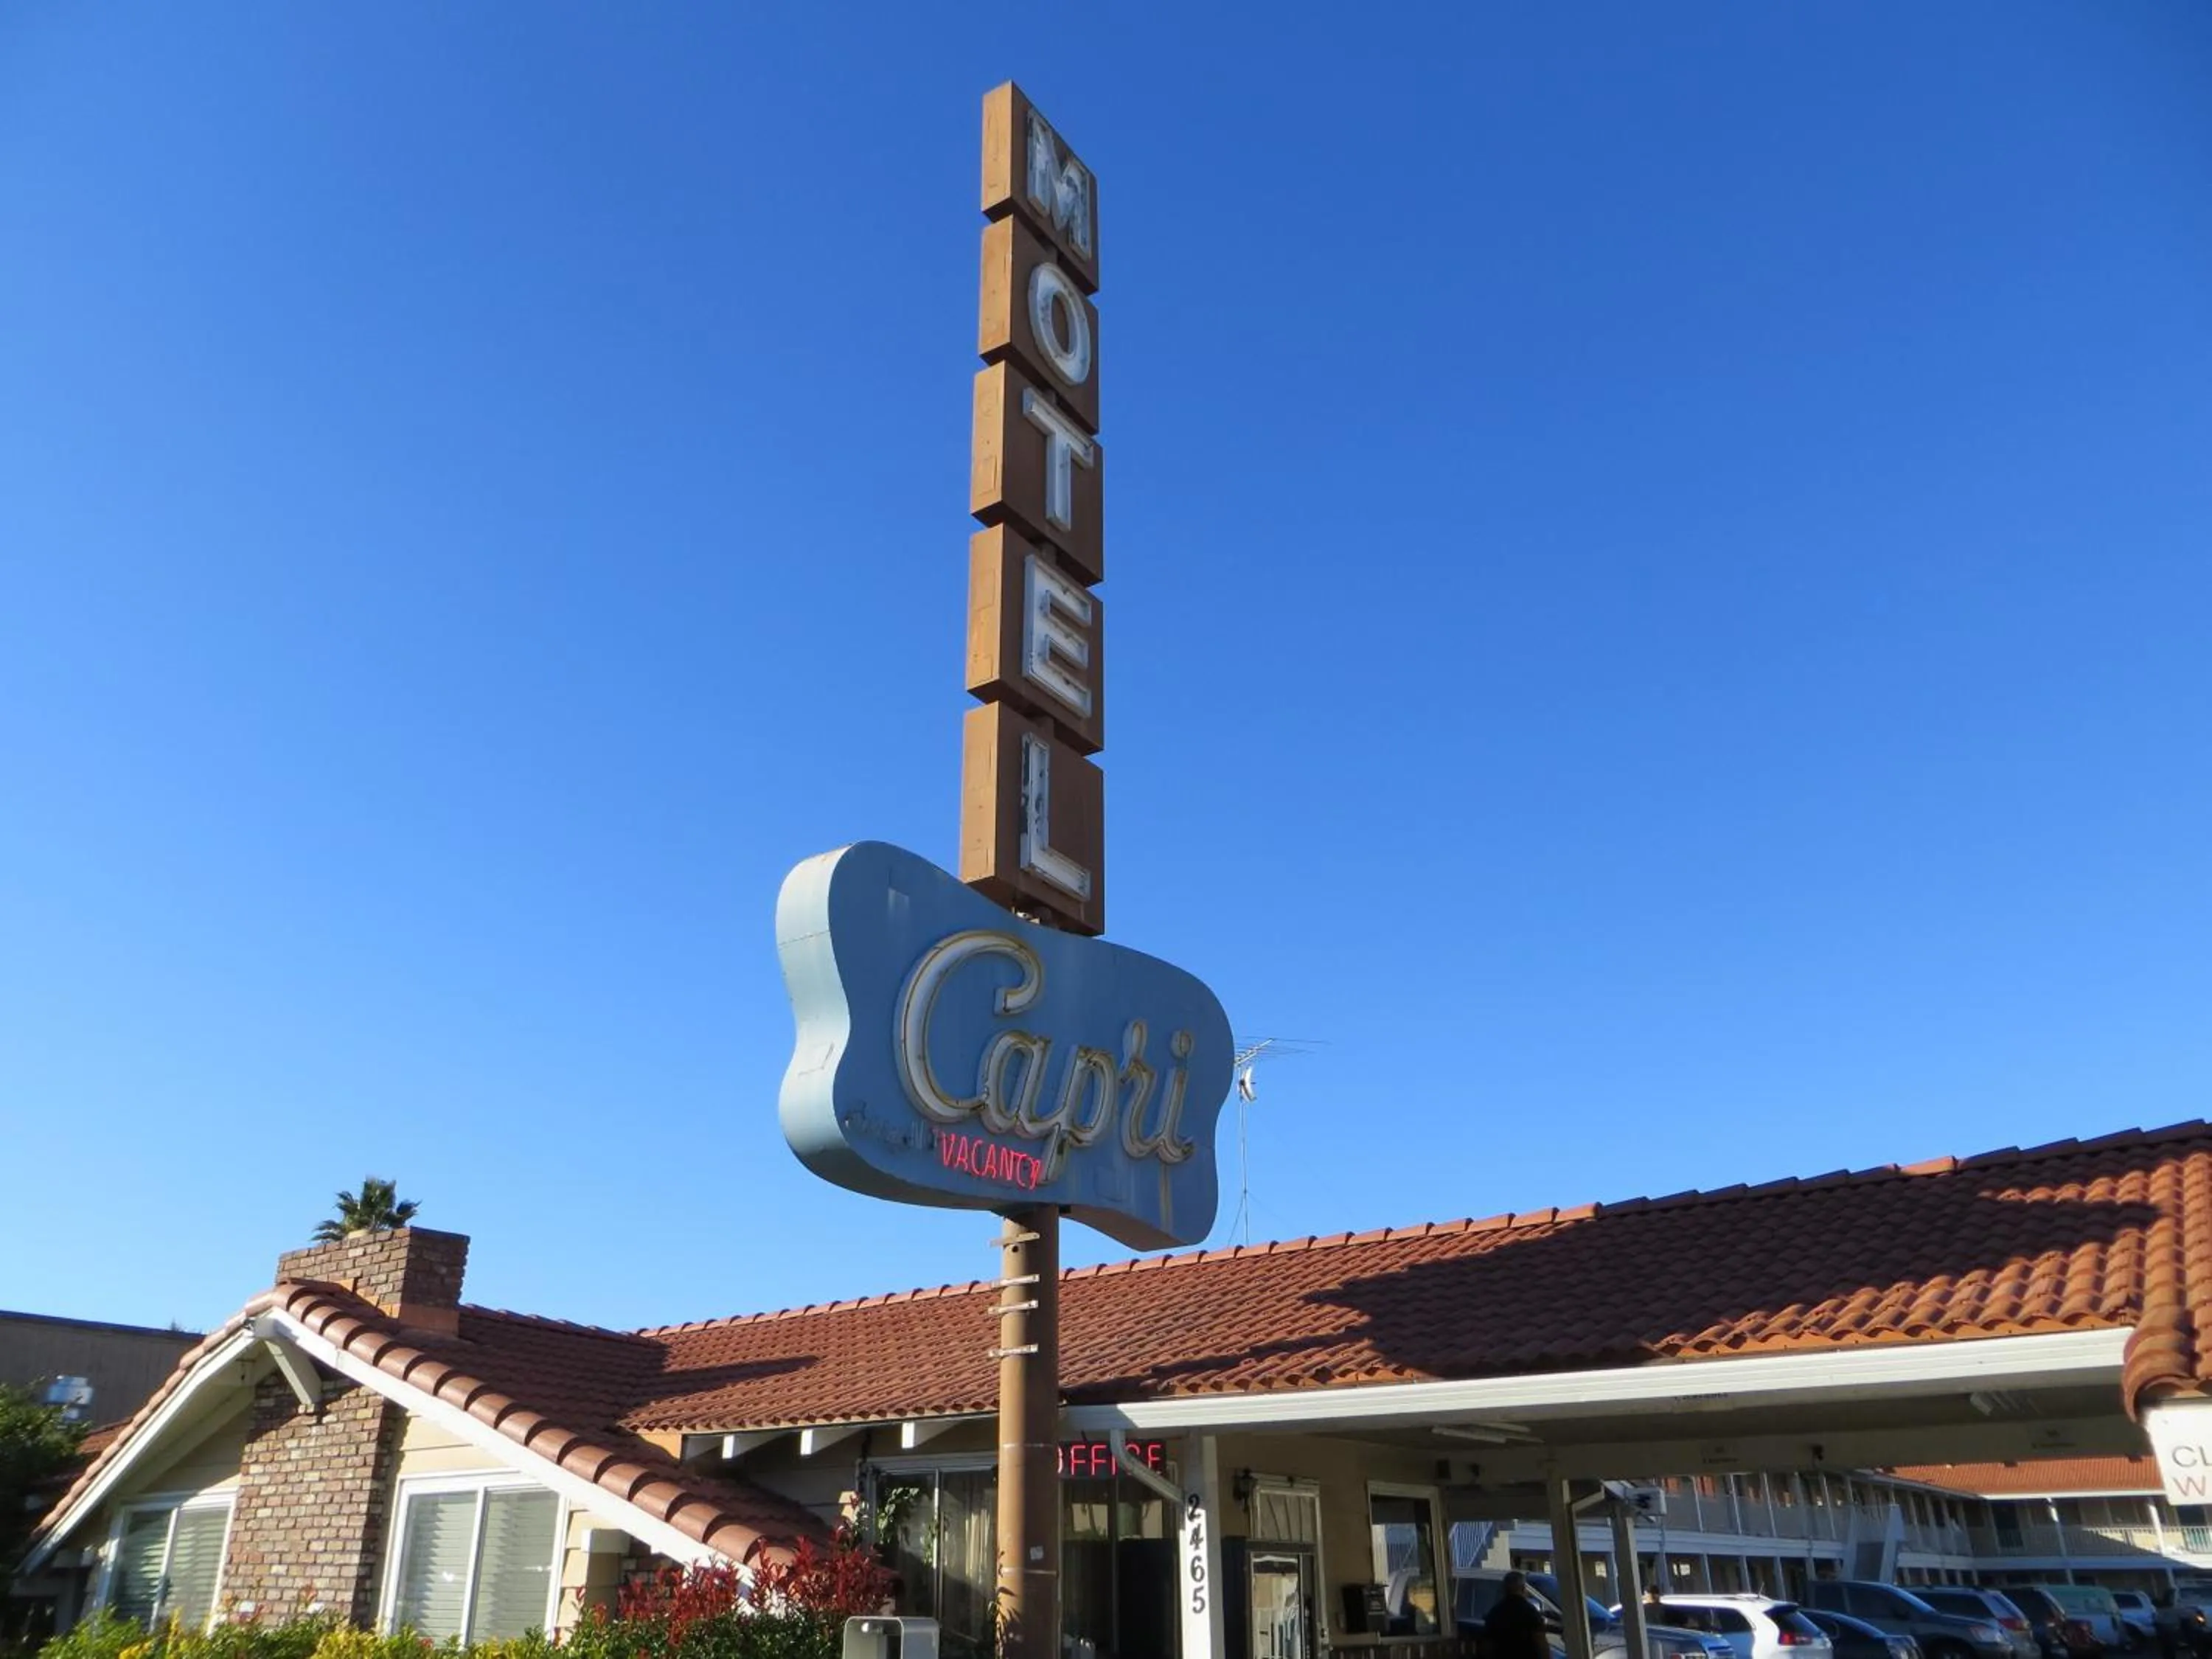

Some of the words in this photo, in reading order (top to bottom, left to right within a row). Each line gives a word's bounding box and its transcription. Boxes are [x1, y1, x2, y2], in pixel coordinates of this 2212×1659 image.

[1020, 106, 1093, 901] MOTEL
[894, 930, 1194, 1183] Capri
[940, 1133, 1043, 1190] VACANCY
[1187, 1493, 1206, 1614] 2465
